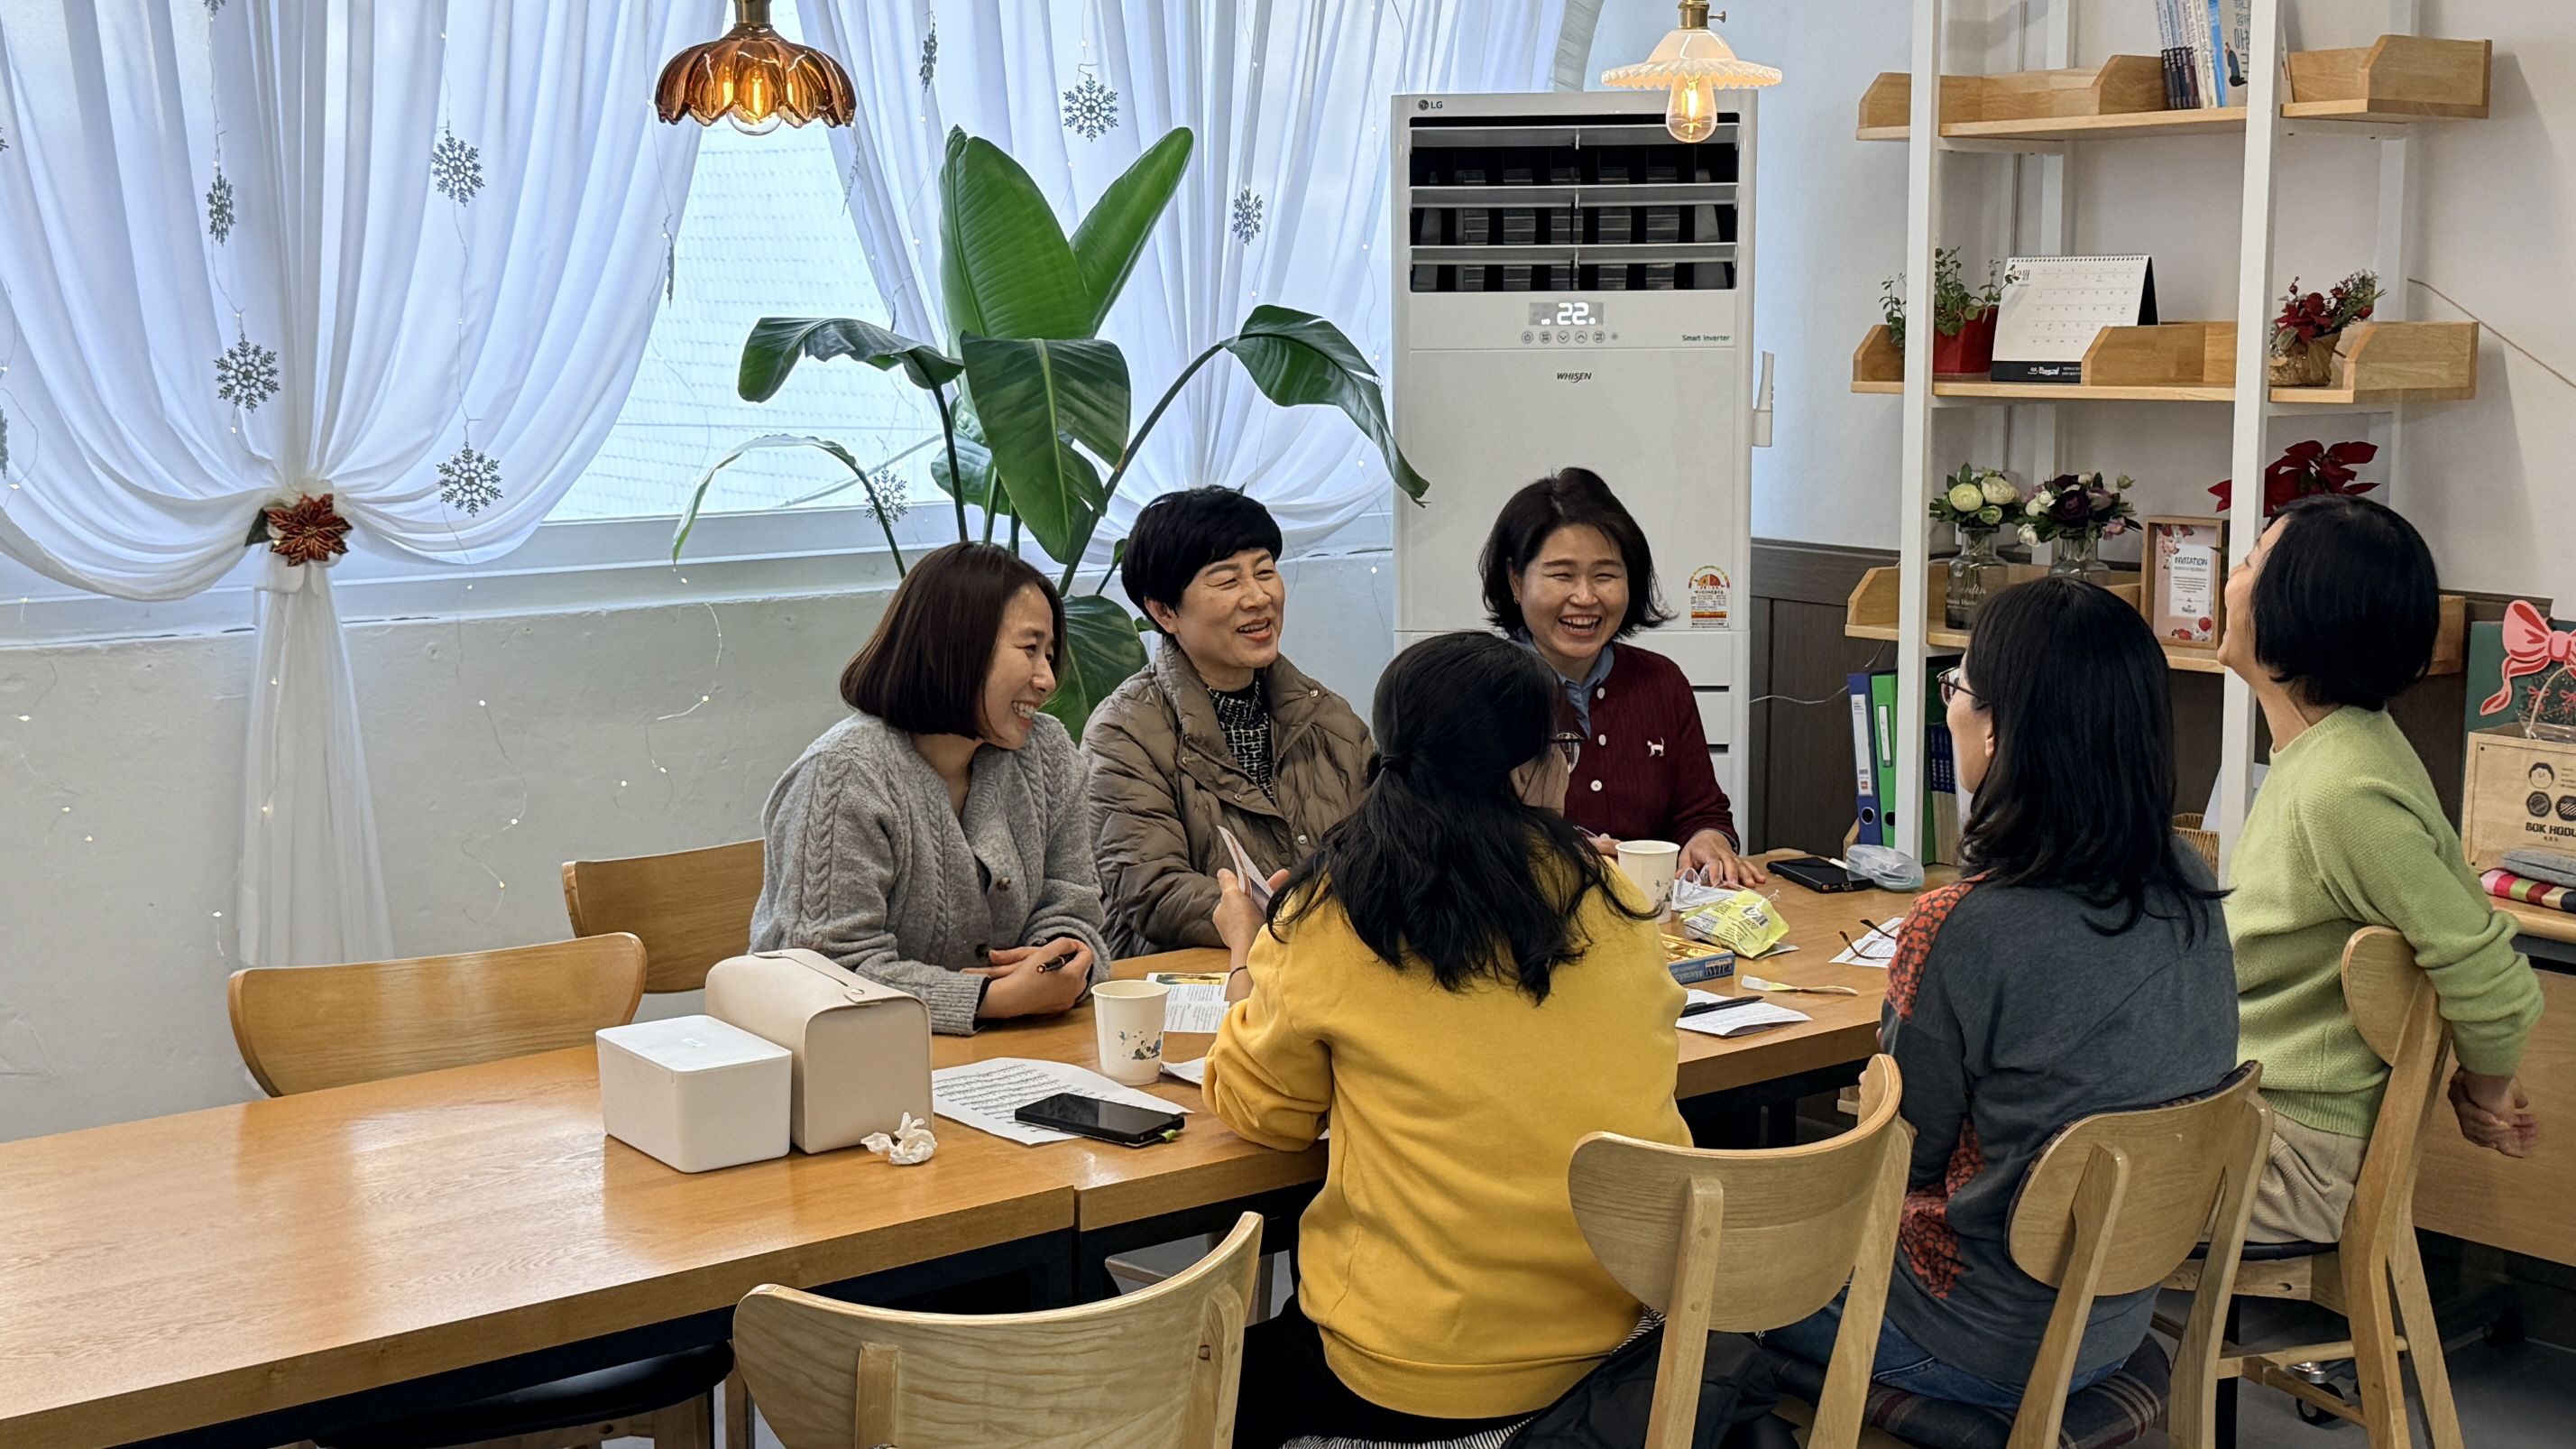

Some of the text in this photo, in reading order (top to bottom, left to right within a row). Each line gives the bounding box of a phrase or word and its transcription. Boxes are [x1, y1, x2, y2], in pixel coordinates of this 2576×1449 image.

[1431, 101, 1443, 109] LG
[1557, 372, 1592, 383] WHISEN
[2174, 556, 2208, 567] INVITATION
[2525, 822, 2546, 834] BOK
